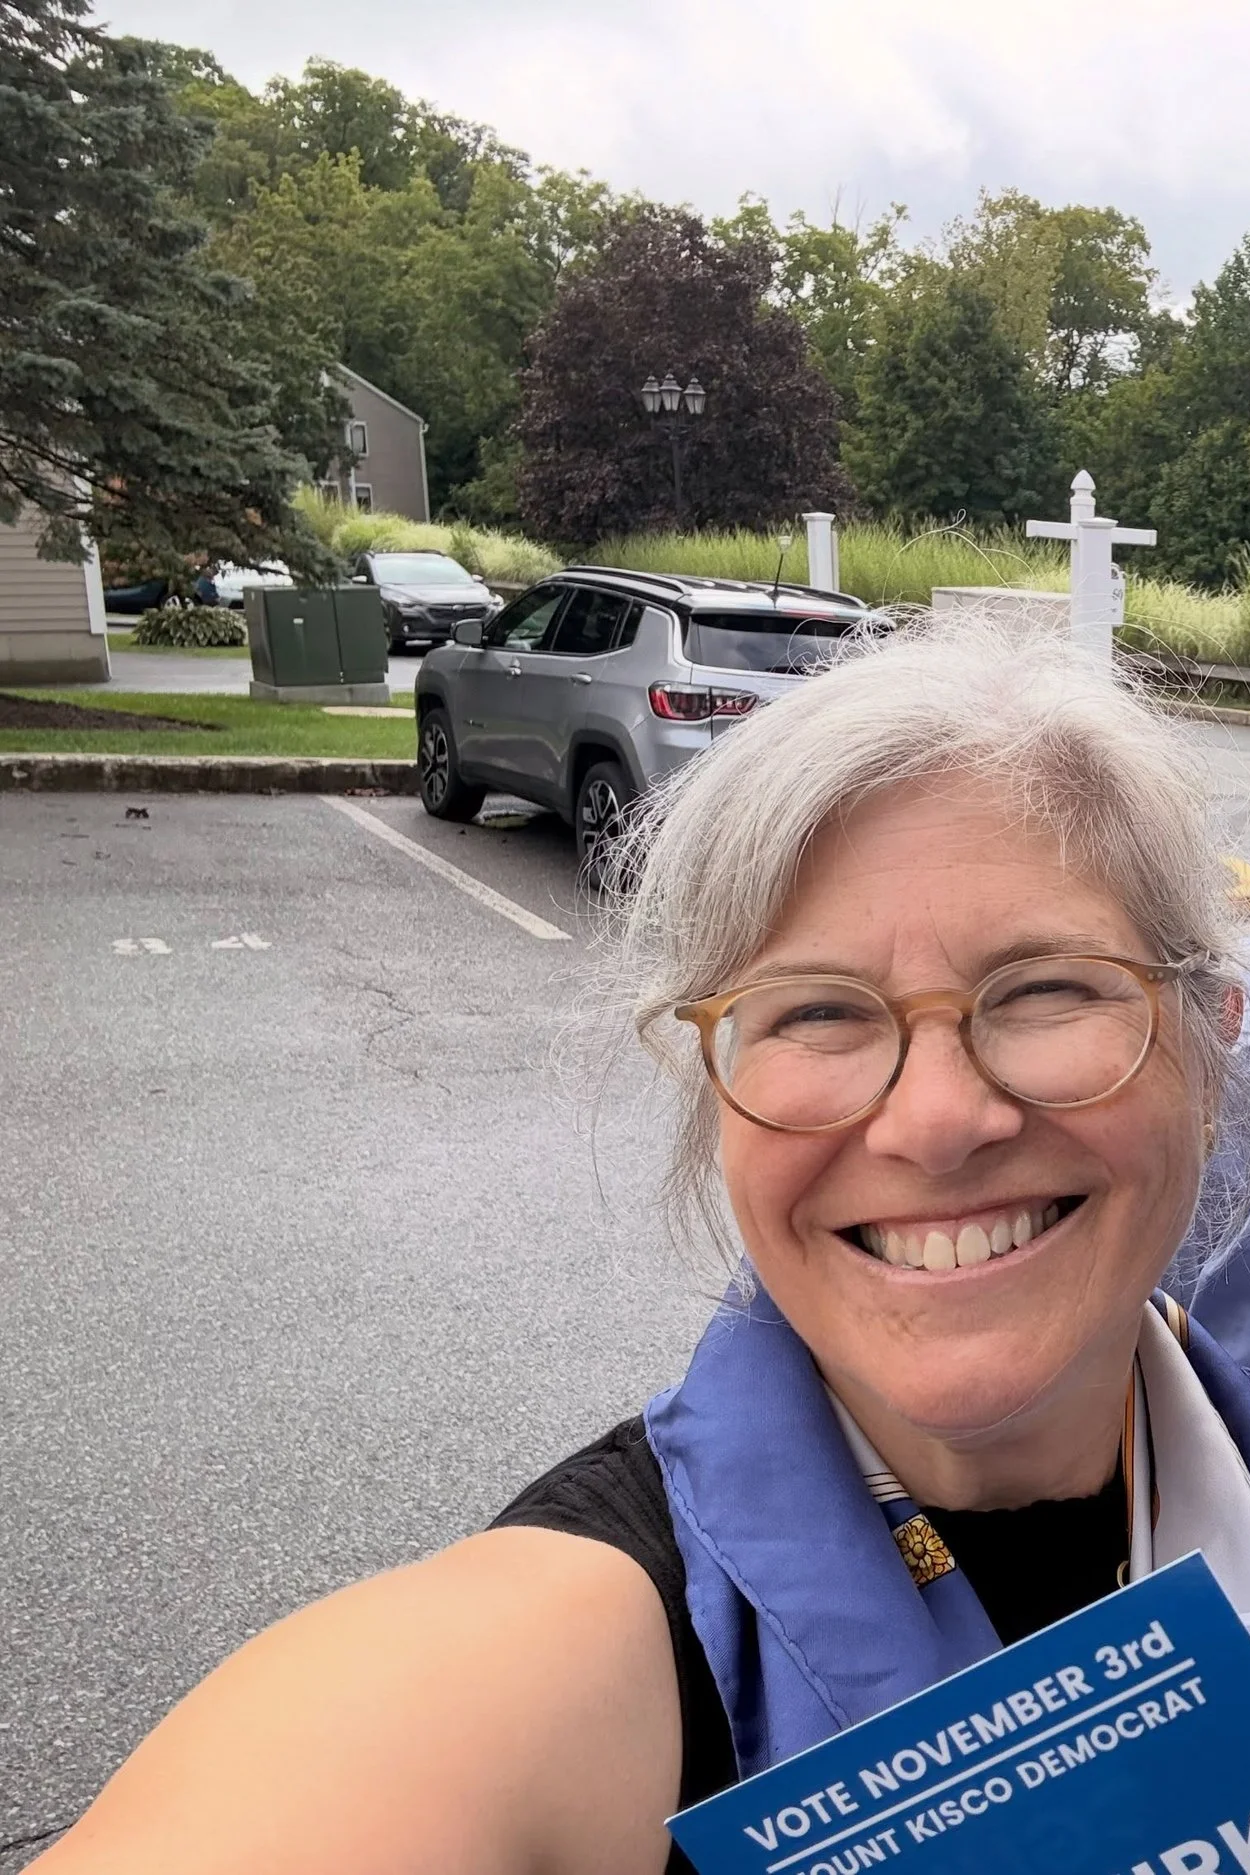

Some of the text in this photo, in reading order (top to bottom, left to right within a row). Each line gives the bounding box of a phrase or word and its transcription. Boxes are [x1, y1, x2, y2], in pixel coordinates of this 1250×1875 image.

[743, 1621, 1176, 1852] VOTE NOVEMBER 3rd
[904, 1776, 1013, 1845] KISCO
[1015, 1676, 1208, 1790] DEMOCRAT
